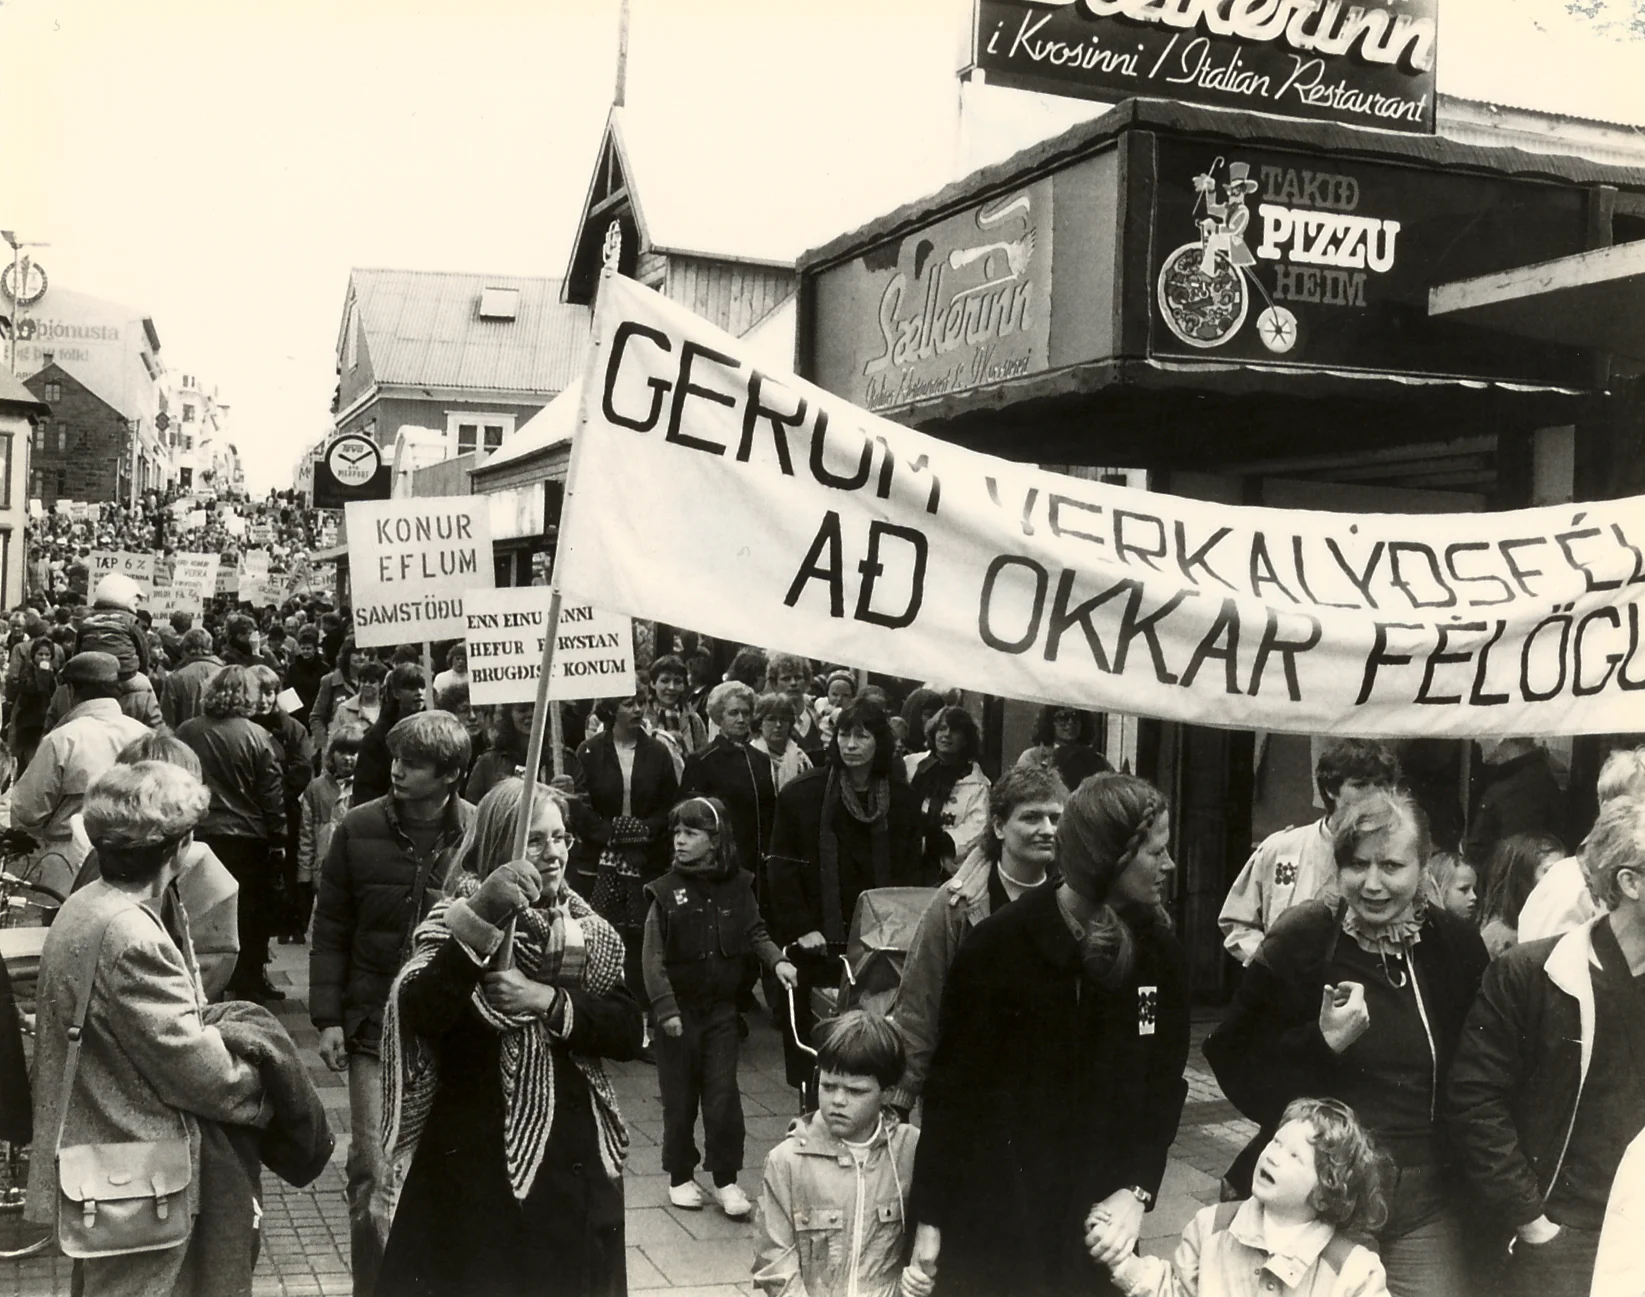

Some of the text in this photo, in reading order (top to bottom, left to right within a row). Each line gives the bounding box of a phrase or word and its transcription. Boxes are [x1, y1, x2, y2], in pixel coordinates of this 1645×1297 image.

[987, 21, 1004, 54] i
[1008, 9, 1144, 77] Kvosinni
[1166, 36, 1269, 97] Italian
[1274, 53, 1427, 122] Restaurant
[1261, 165, 1359, 211] TAKIÐ
[1257, 203, 1401, 273] PIZZU
[1272, 264, 1367, 307] HEIM
[602, 321, 941, 514] GERUM
[376, 513, 473, 544] KONUR
[95, 556, 119, 569] TÆP
[124, 558, 133, 570] 6
[379, 548, 478, 582] EFLUM
[783, 510, 930, 630] AÐ
[355, 594, 464, 627] SAMSTÖÐU
[466, 614, 499, 630] ENN
[503, 611, 543, 628] EINU
[978, 554, 1322, 702] OKKAR
[469, 633, 620, 658] HEFUR FRYSTAN
[562, 659, 627, 677] KONUM
